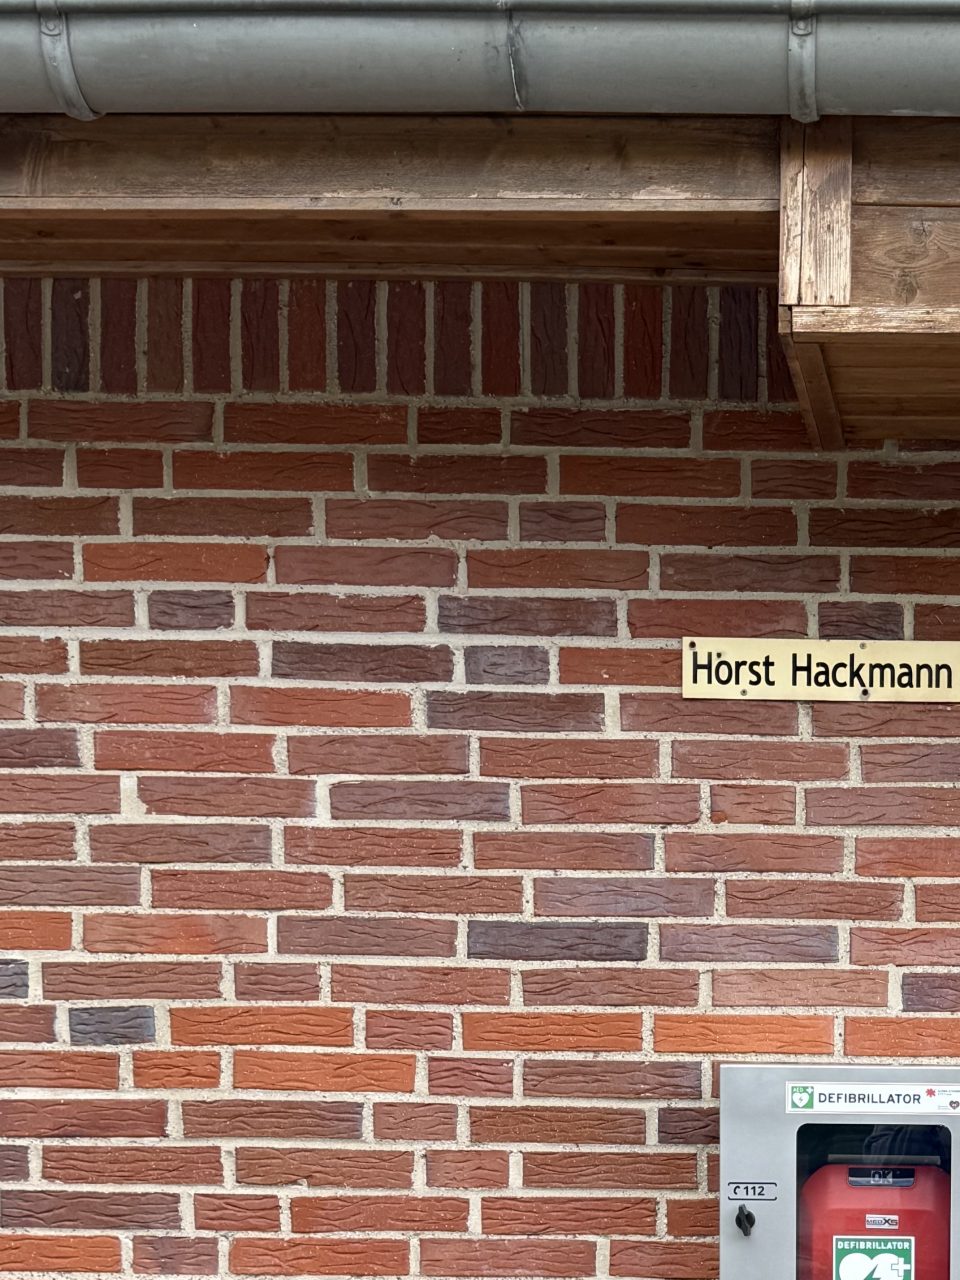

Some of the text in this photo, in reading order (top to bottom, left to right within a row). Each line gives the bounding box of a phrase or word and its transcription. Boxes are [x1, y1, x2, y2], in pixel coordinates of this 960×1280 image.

[691, 651, 775, 687] Horst
[791, 652, 953, 689] Hackmann
[818, 1092, 921, 1105] DEFIBRILLATOR
[743, 1185, 765, 1196] 112
[837, 1241, 910, 1250] DEFIBRILLATOR
